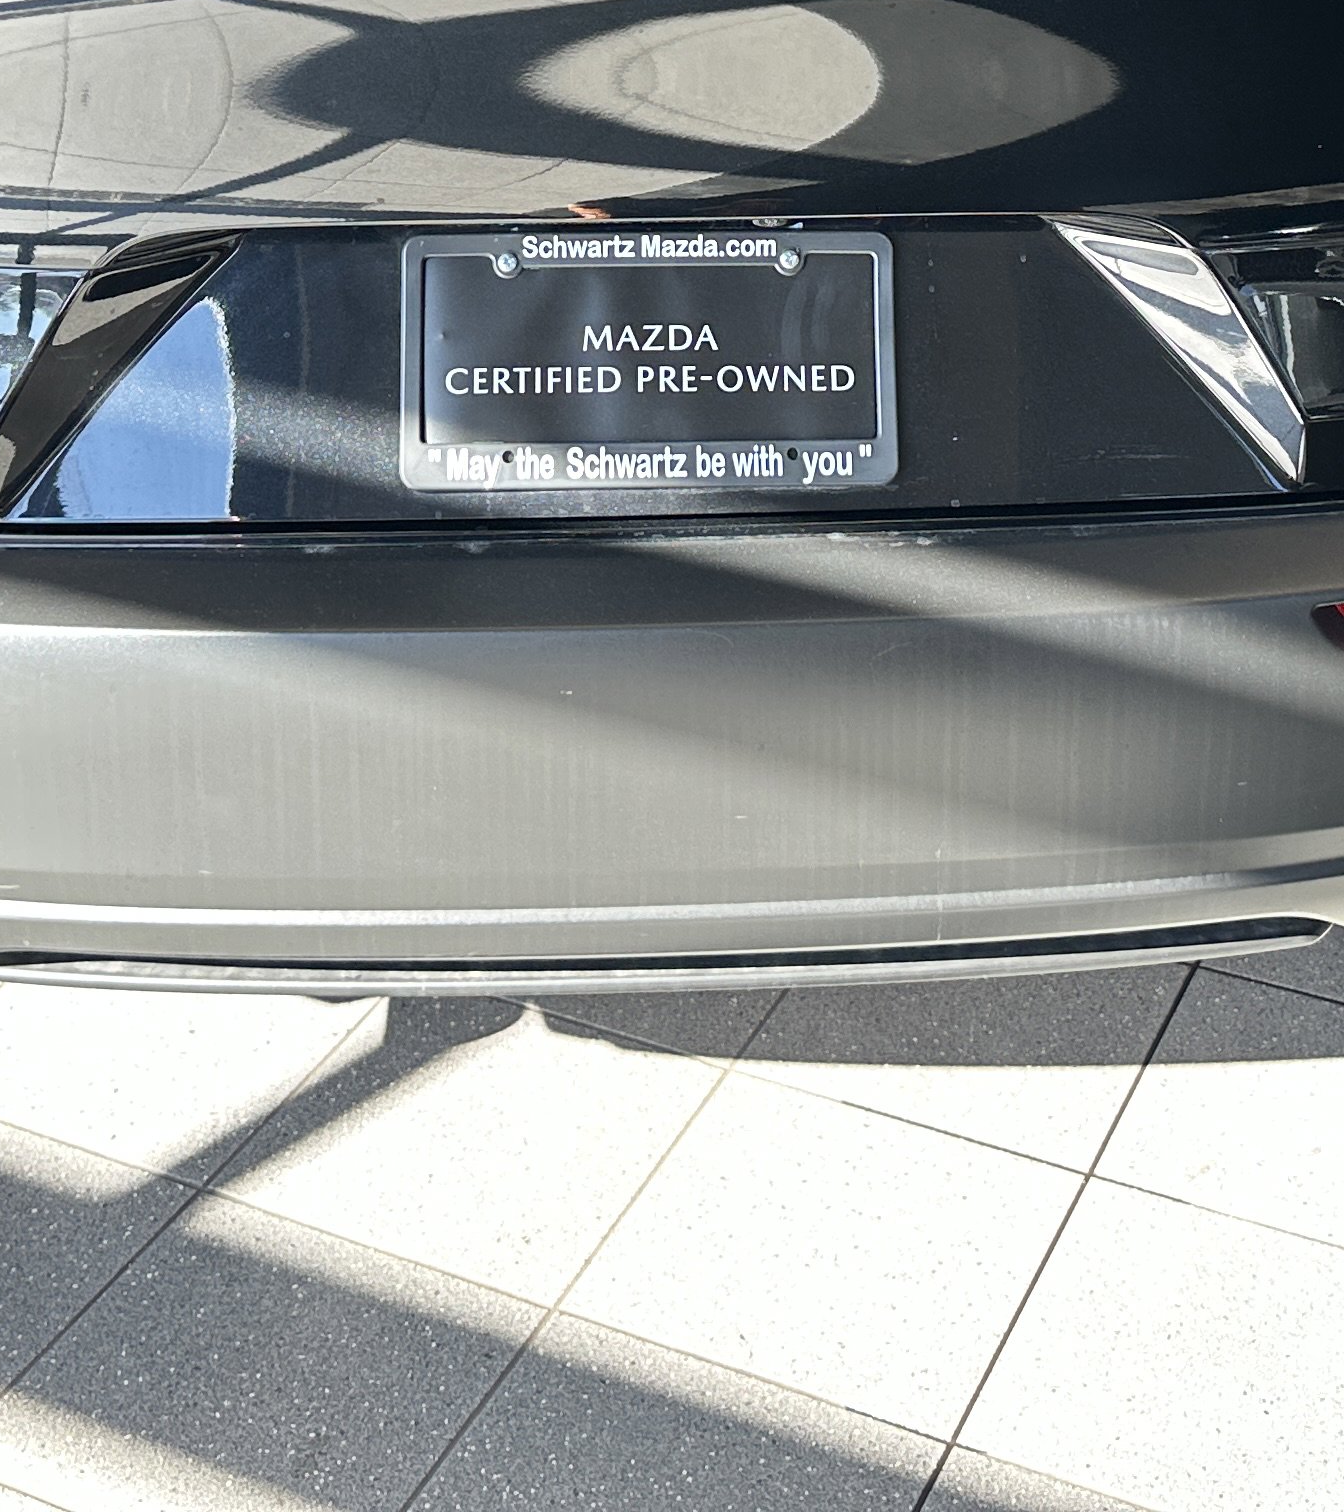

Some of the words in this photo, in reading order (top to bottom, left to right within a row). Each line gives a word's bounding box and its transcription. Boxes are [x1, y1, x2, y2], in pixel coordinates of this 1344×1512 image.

[522, 235, 635, 258] Schwartz
[641, 234, 777, 258] Mazda.com
[582, 324, 719, 352] MAZDA
[444, 366, 622, 395] CERTIFIED
[636, 364, 856, 393] PRE-OWNED
[515, 448, 555, 479] the
[566, 447, 688, 480] Schwartz
[696, 446, 726, 478] be
[732, 445, 785, 478] with
